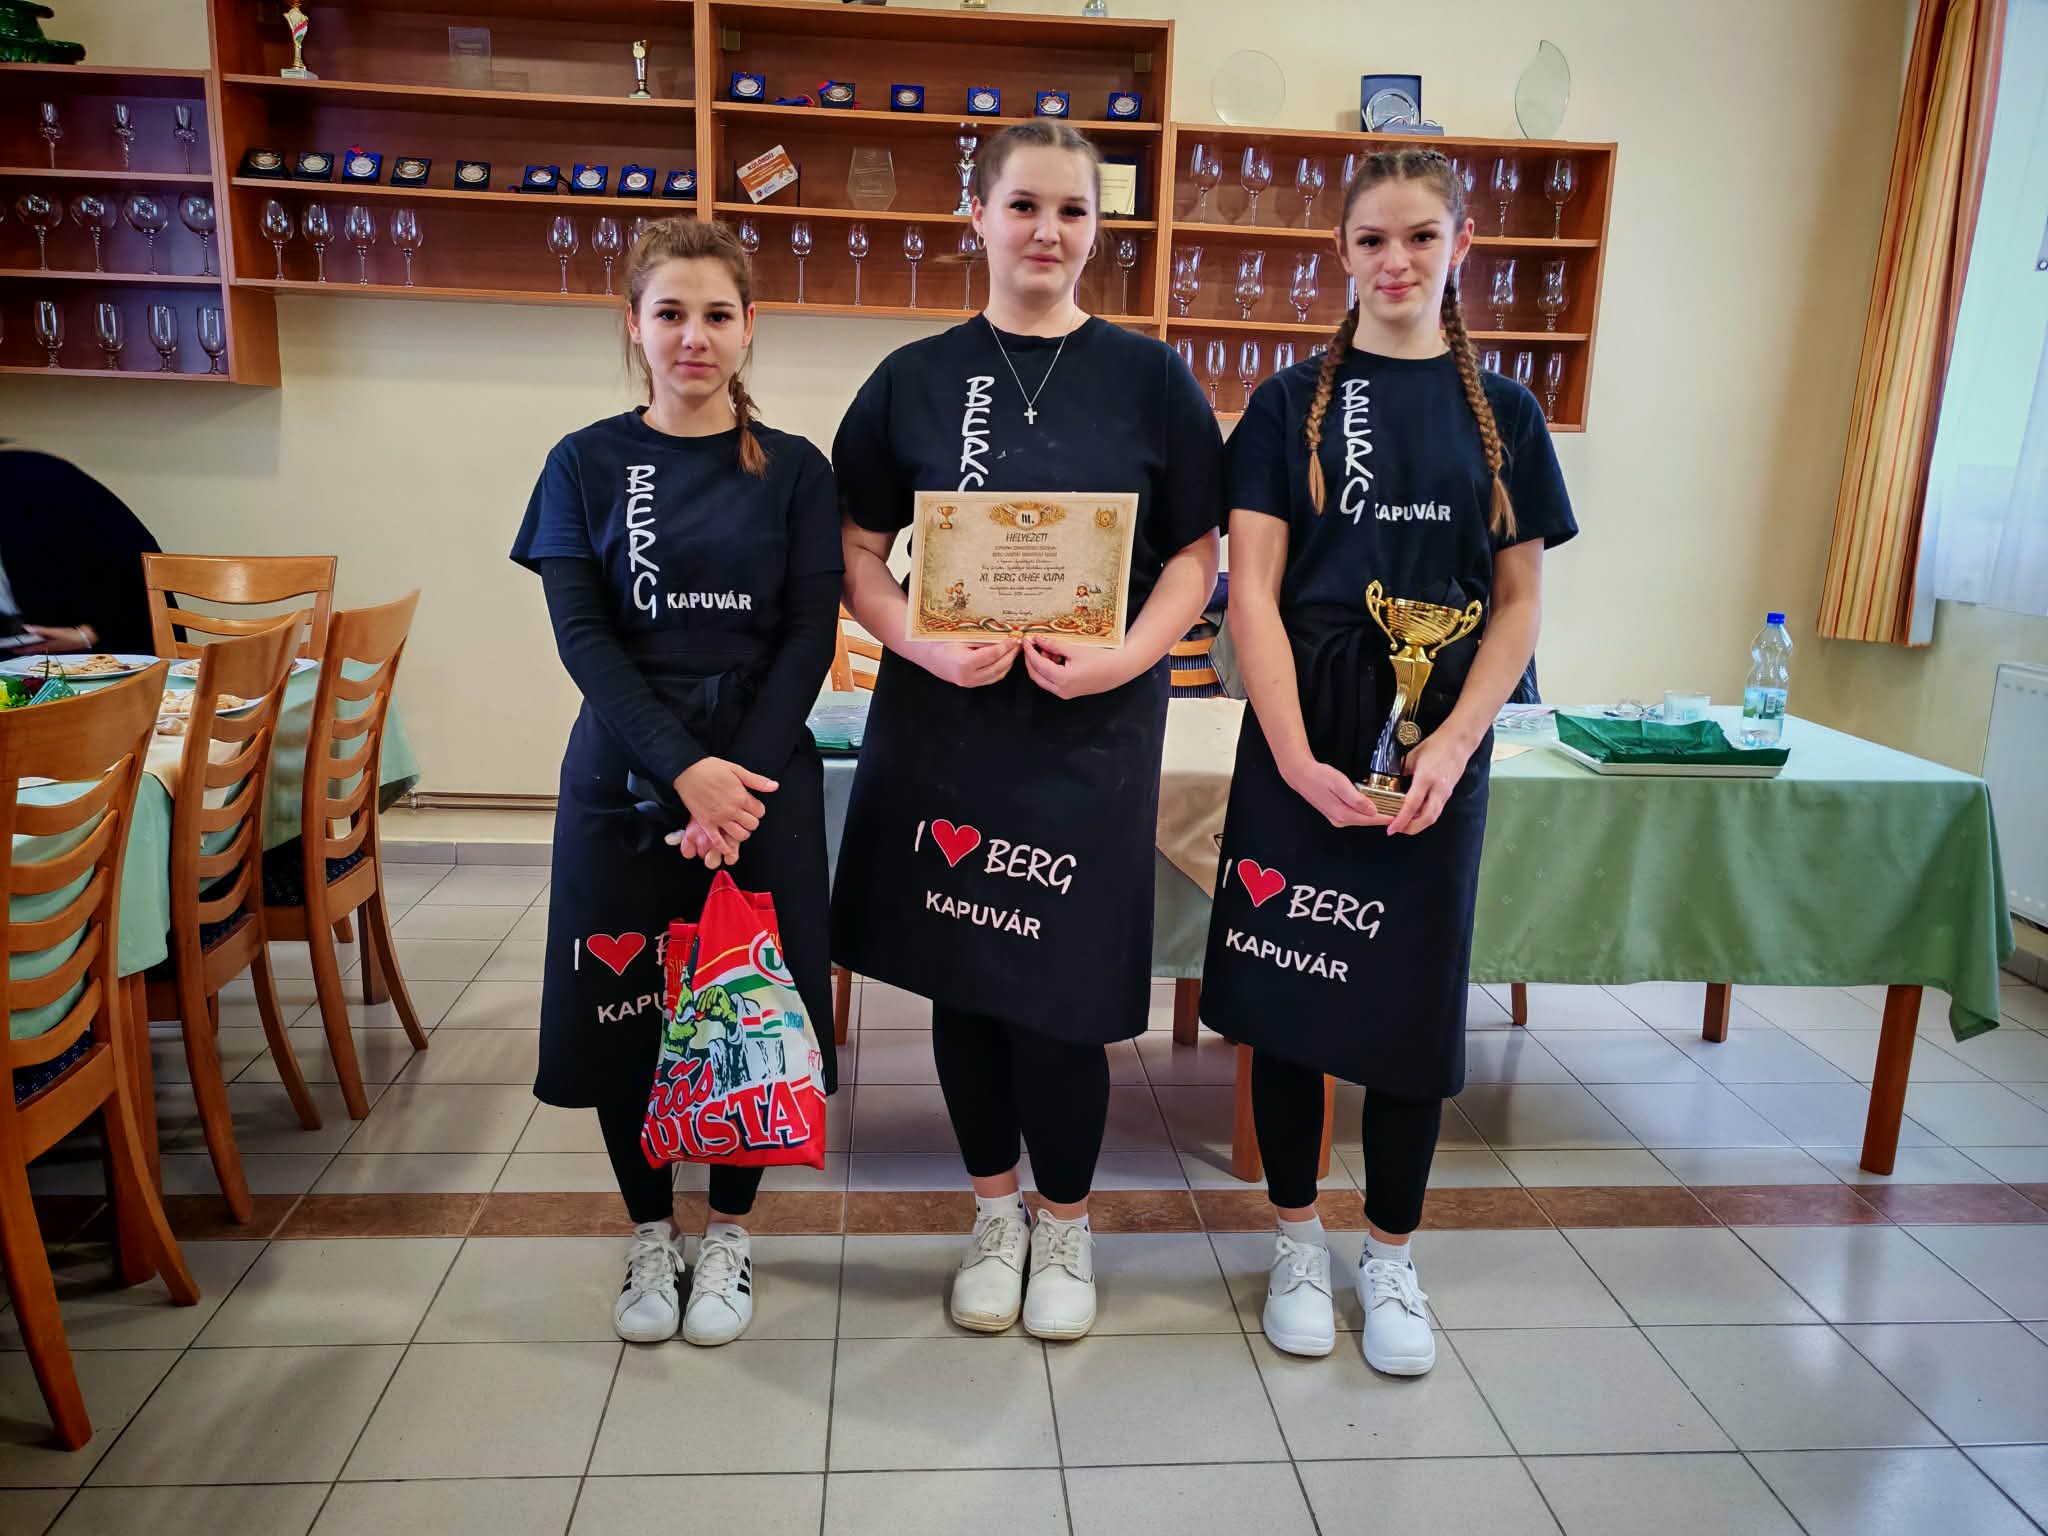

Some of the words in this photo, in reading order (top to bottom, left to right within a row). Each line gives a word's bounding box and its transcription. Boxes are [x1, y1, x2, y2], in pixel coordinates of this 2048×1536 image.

[1339, 378, 1375, 525] BERG
[626, 464, 660, 620] BERG
[667, 589, 752, 611] KAPUVÁR
[993, 572, 1016, 582] BERG
[1042, 572, 1065, 582] KUPA
[914, 820, 926, 853] I
[983, 838, 1078, 896] BERG
[925, 889, 1041, 940] KAPUVÁR
[1222, 858, 1233, 889] I
[1286, 884, 1385, 940] BERG
[574, 938, 580, 971] I
[1225, 927, 1349, 983] KAPUVÁR
